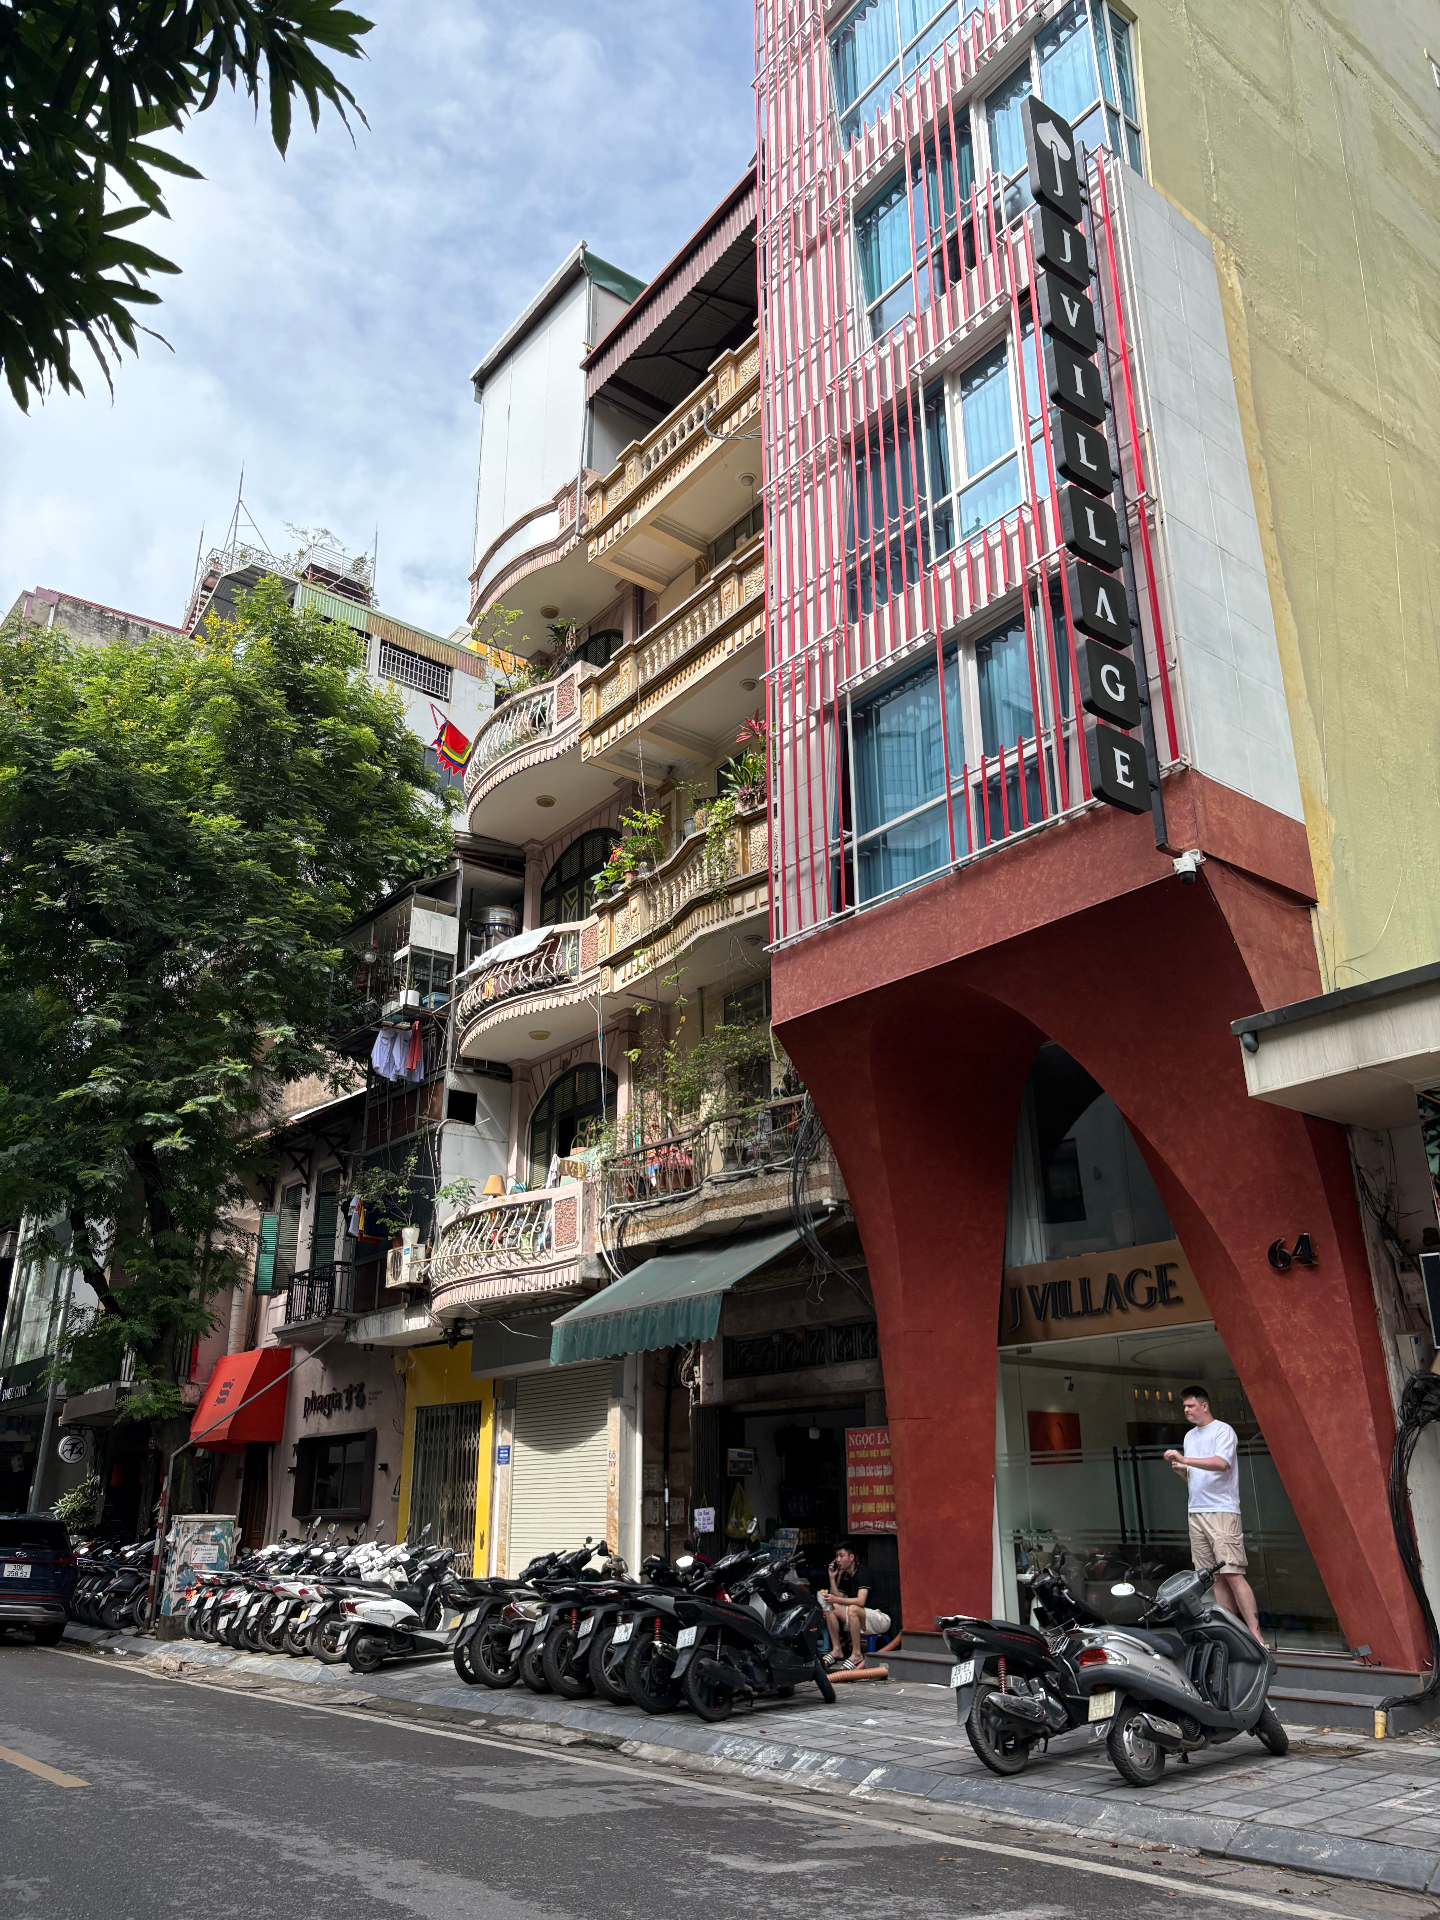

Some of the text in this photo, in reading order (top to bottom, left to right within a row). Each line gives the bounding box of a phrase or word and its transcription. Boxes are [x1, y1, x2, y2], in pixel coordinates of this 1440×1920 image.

[1060, 291, 1134, 790] VILLAGE
[1267, 1232, 1318, 1270] 64
[1008, 1262, 1184, 1332] J VILLAGE
[608, 1450, 616, 1460] 66
[849, 1433, 875, 1449] NGỌC
